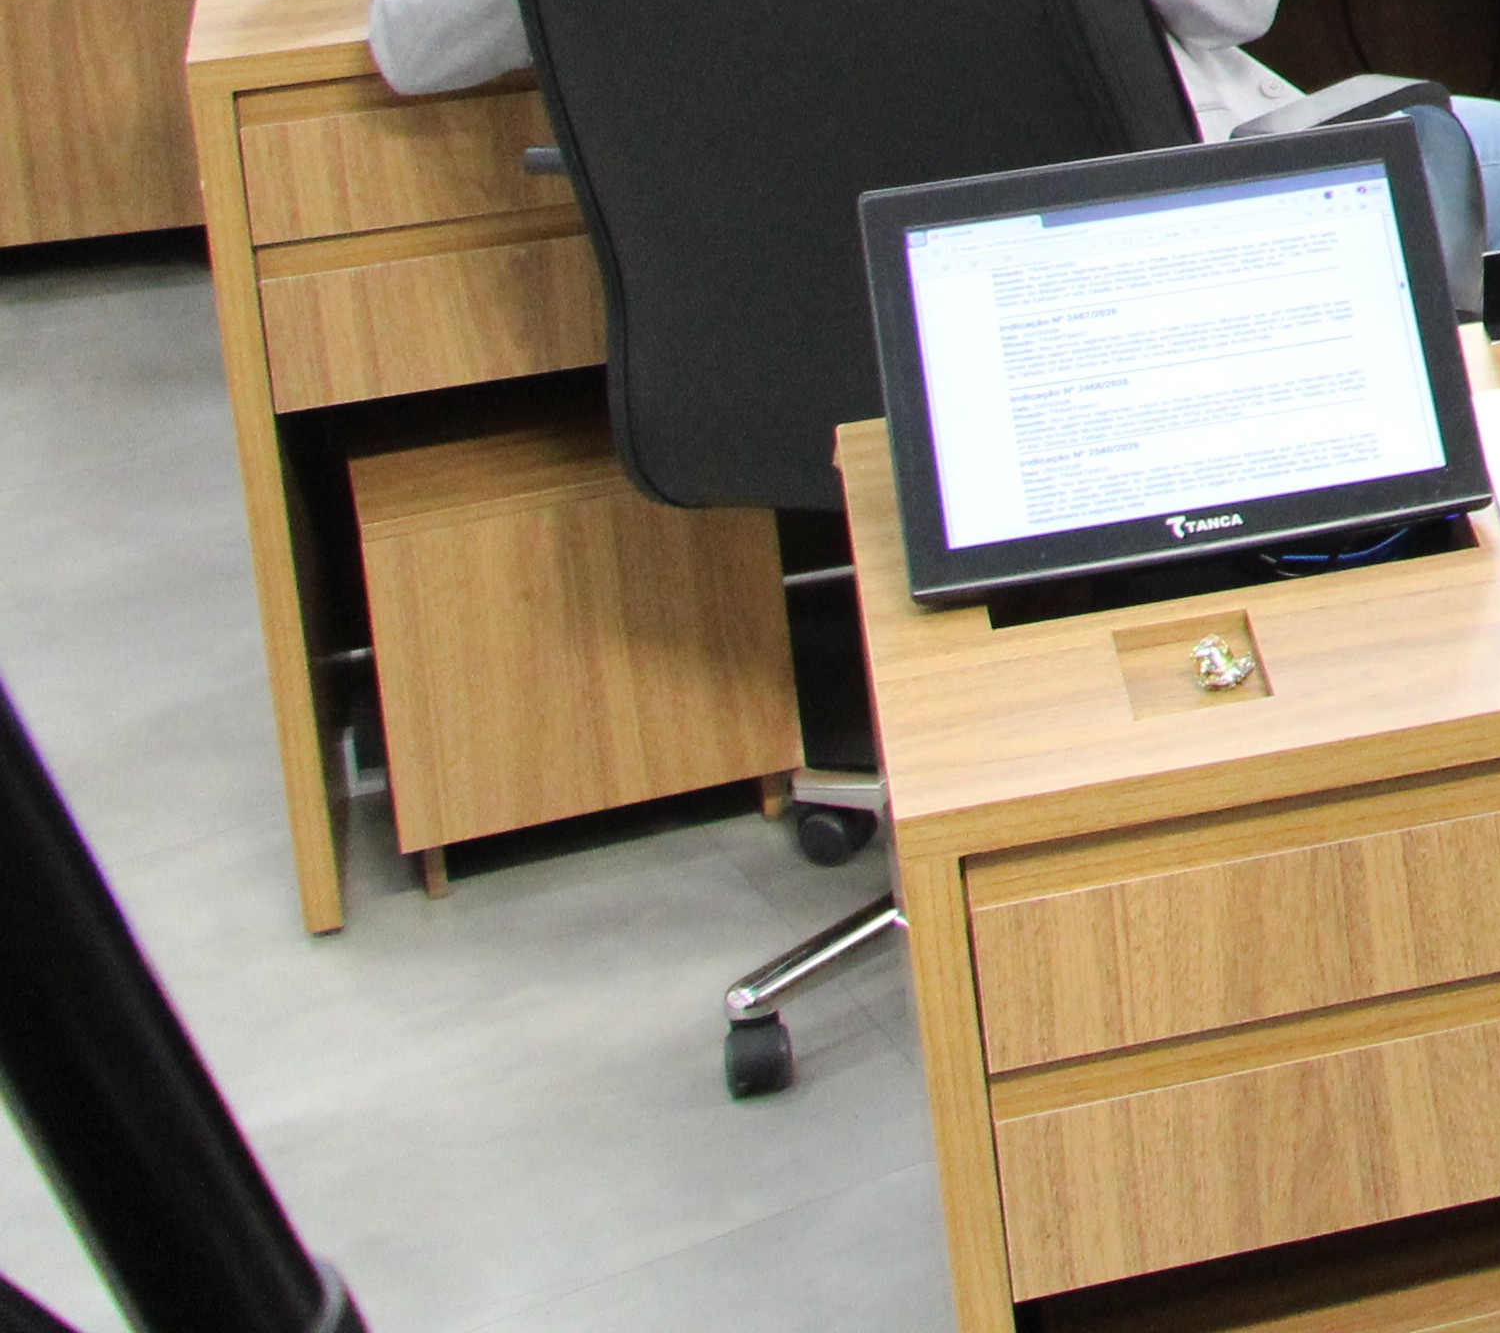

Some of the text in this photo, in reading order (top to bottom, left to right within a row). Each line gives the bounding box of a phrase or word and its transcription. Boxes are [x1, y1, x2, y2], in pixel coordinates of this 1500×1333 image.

[998, 317, 1049, 333] Indicação
[1009, 388, 1060, 404] Indicação
[1019, 452, 1070, 468] Indicação
[1184, 513, 1245, 534] TANCA
